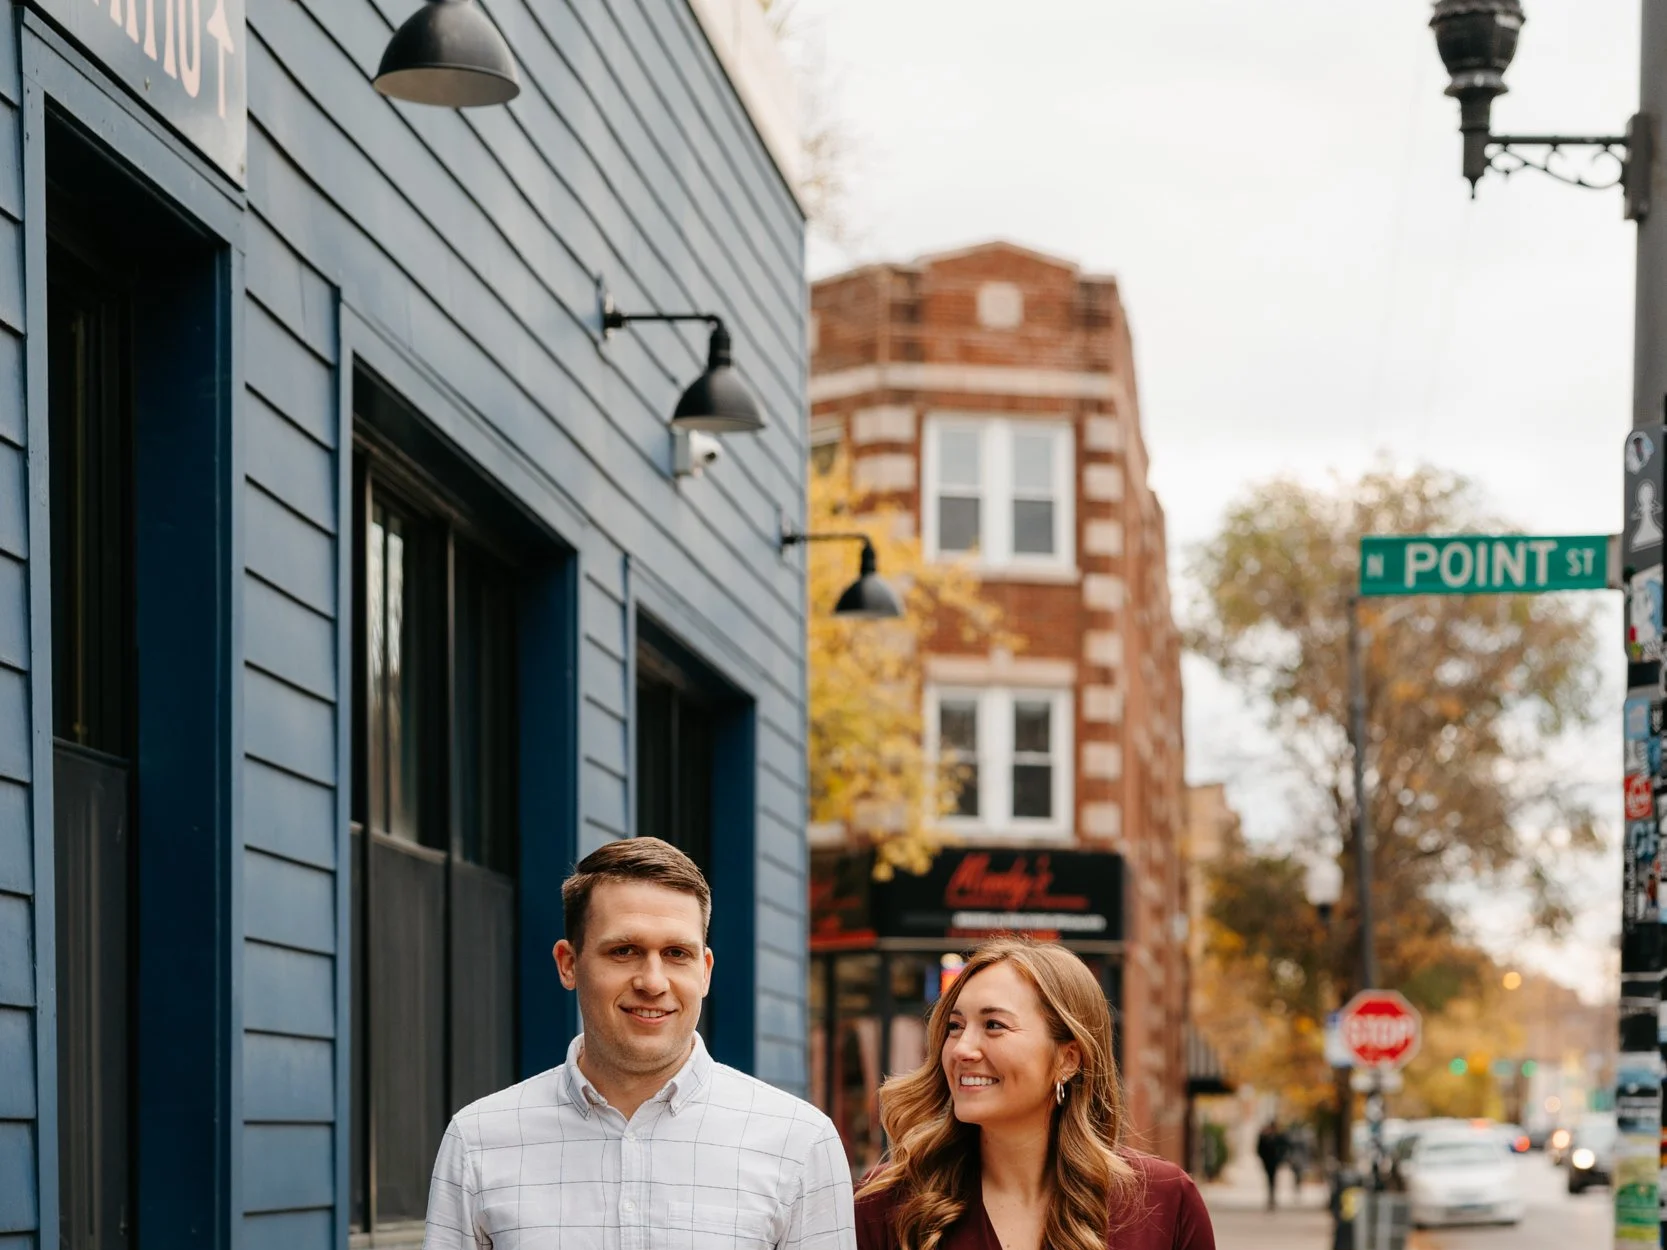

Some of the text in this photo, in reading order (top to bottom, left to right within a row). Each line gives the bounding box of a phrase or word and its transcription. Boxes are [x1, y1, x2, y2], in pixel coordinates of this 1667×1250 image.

[1366, 540, 1596, 588] N POINT ST
[1347, 1014, 1413, 1049] STOP
